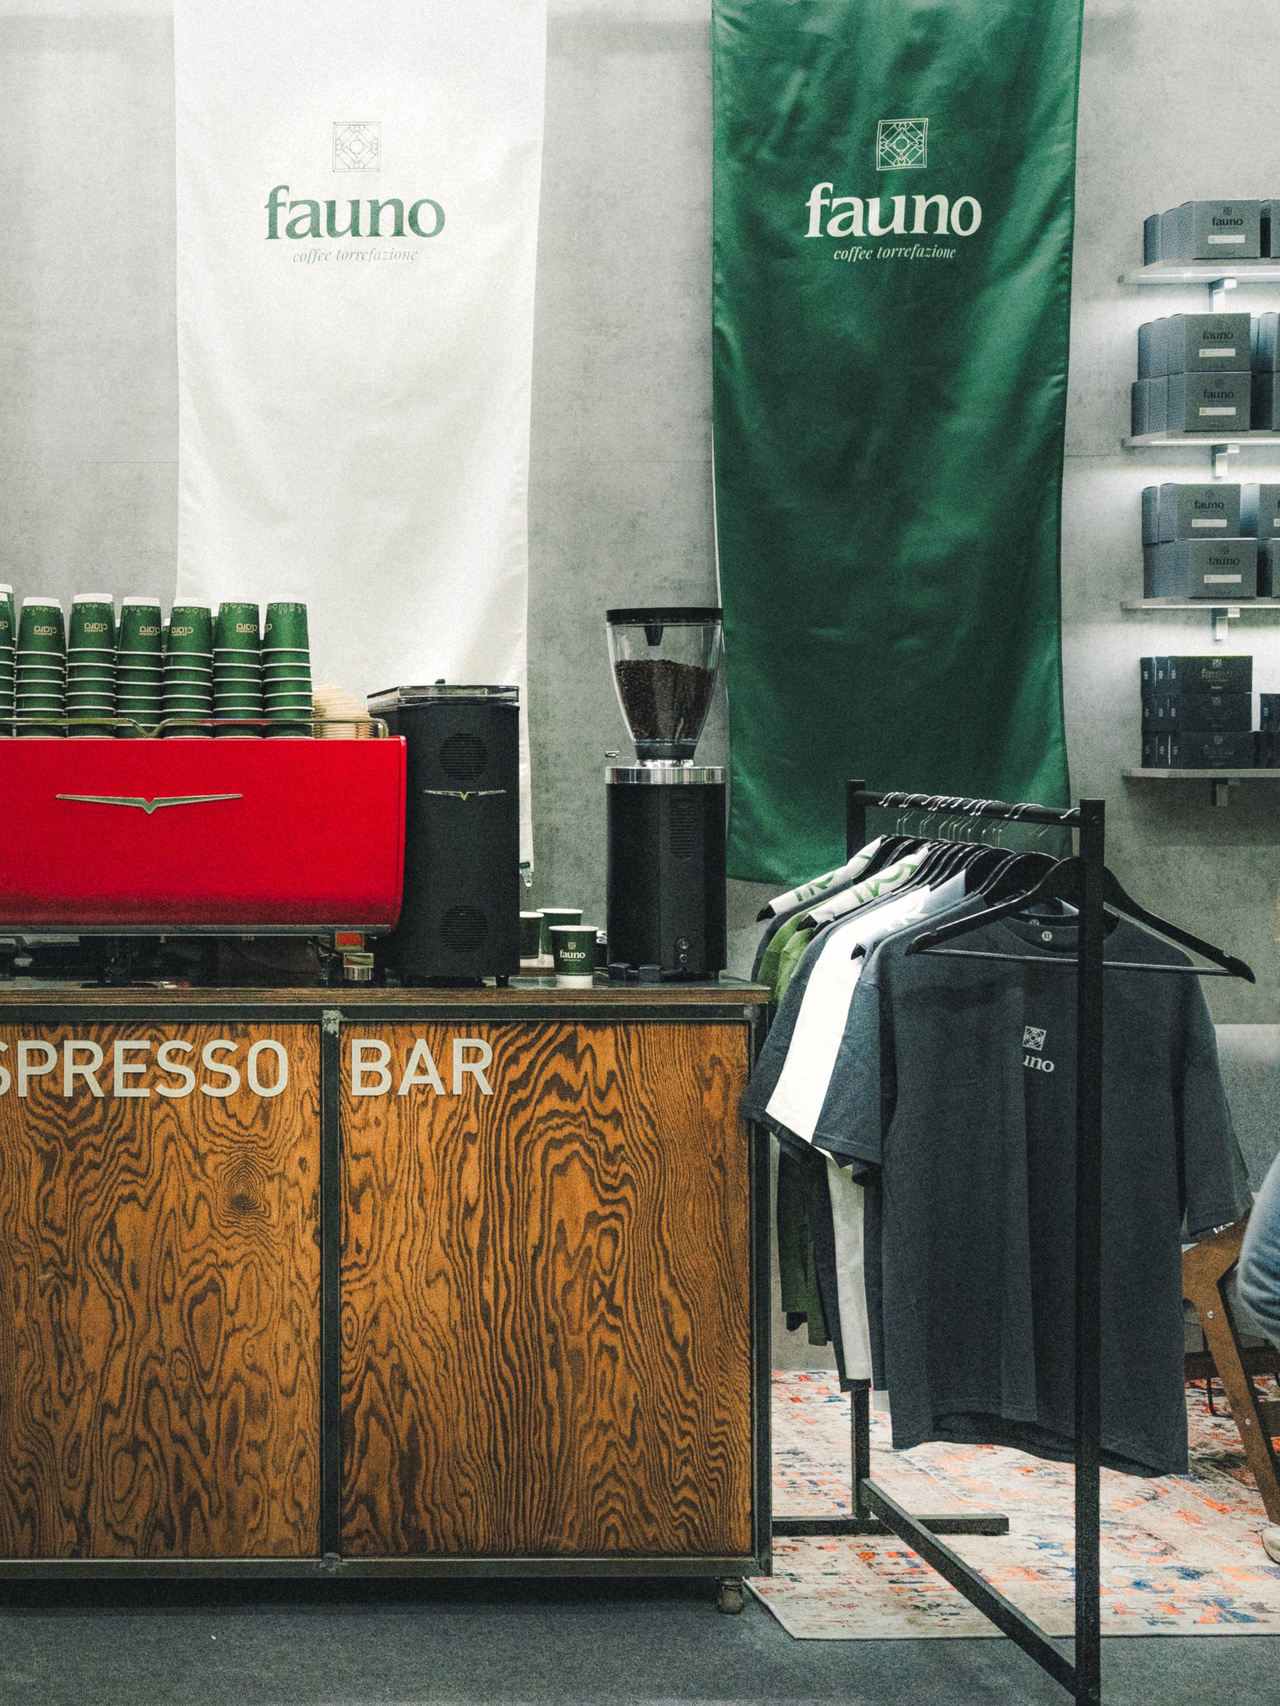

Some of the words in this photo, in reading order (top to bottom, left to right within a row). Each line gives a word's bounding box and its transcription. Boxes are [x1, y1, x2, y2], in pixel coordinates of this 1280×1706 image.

[264, 184, 446, 240] fauno
[804, 182, 982, 238] fauno
[1212, 216, 1243, 227] fauno
[293, 248, 331, 265] coffee
[335, 247, 418, 263] torrefazione
[833, 246, 873, 262] coffee
[876, 244, 956, 260] torrefazione
[1202, 330, 1234, 341] fauno
[1203, 389, 1235, 400] fauno
[1194, 500, 1225, 510] fauno
[1208, 556, 1240, 567] fauno
[559, 949, 586, 959] fauno
[351, 1038, 494, 1097] BAR
